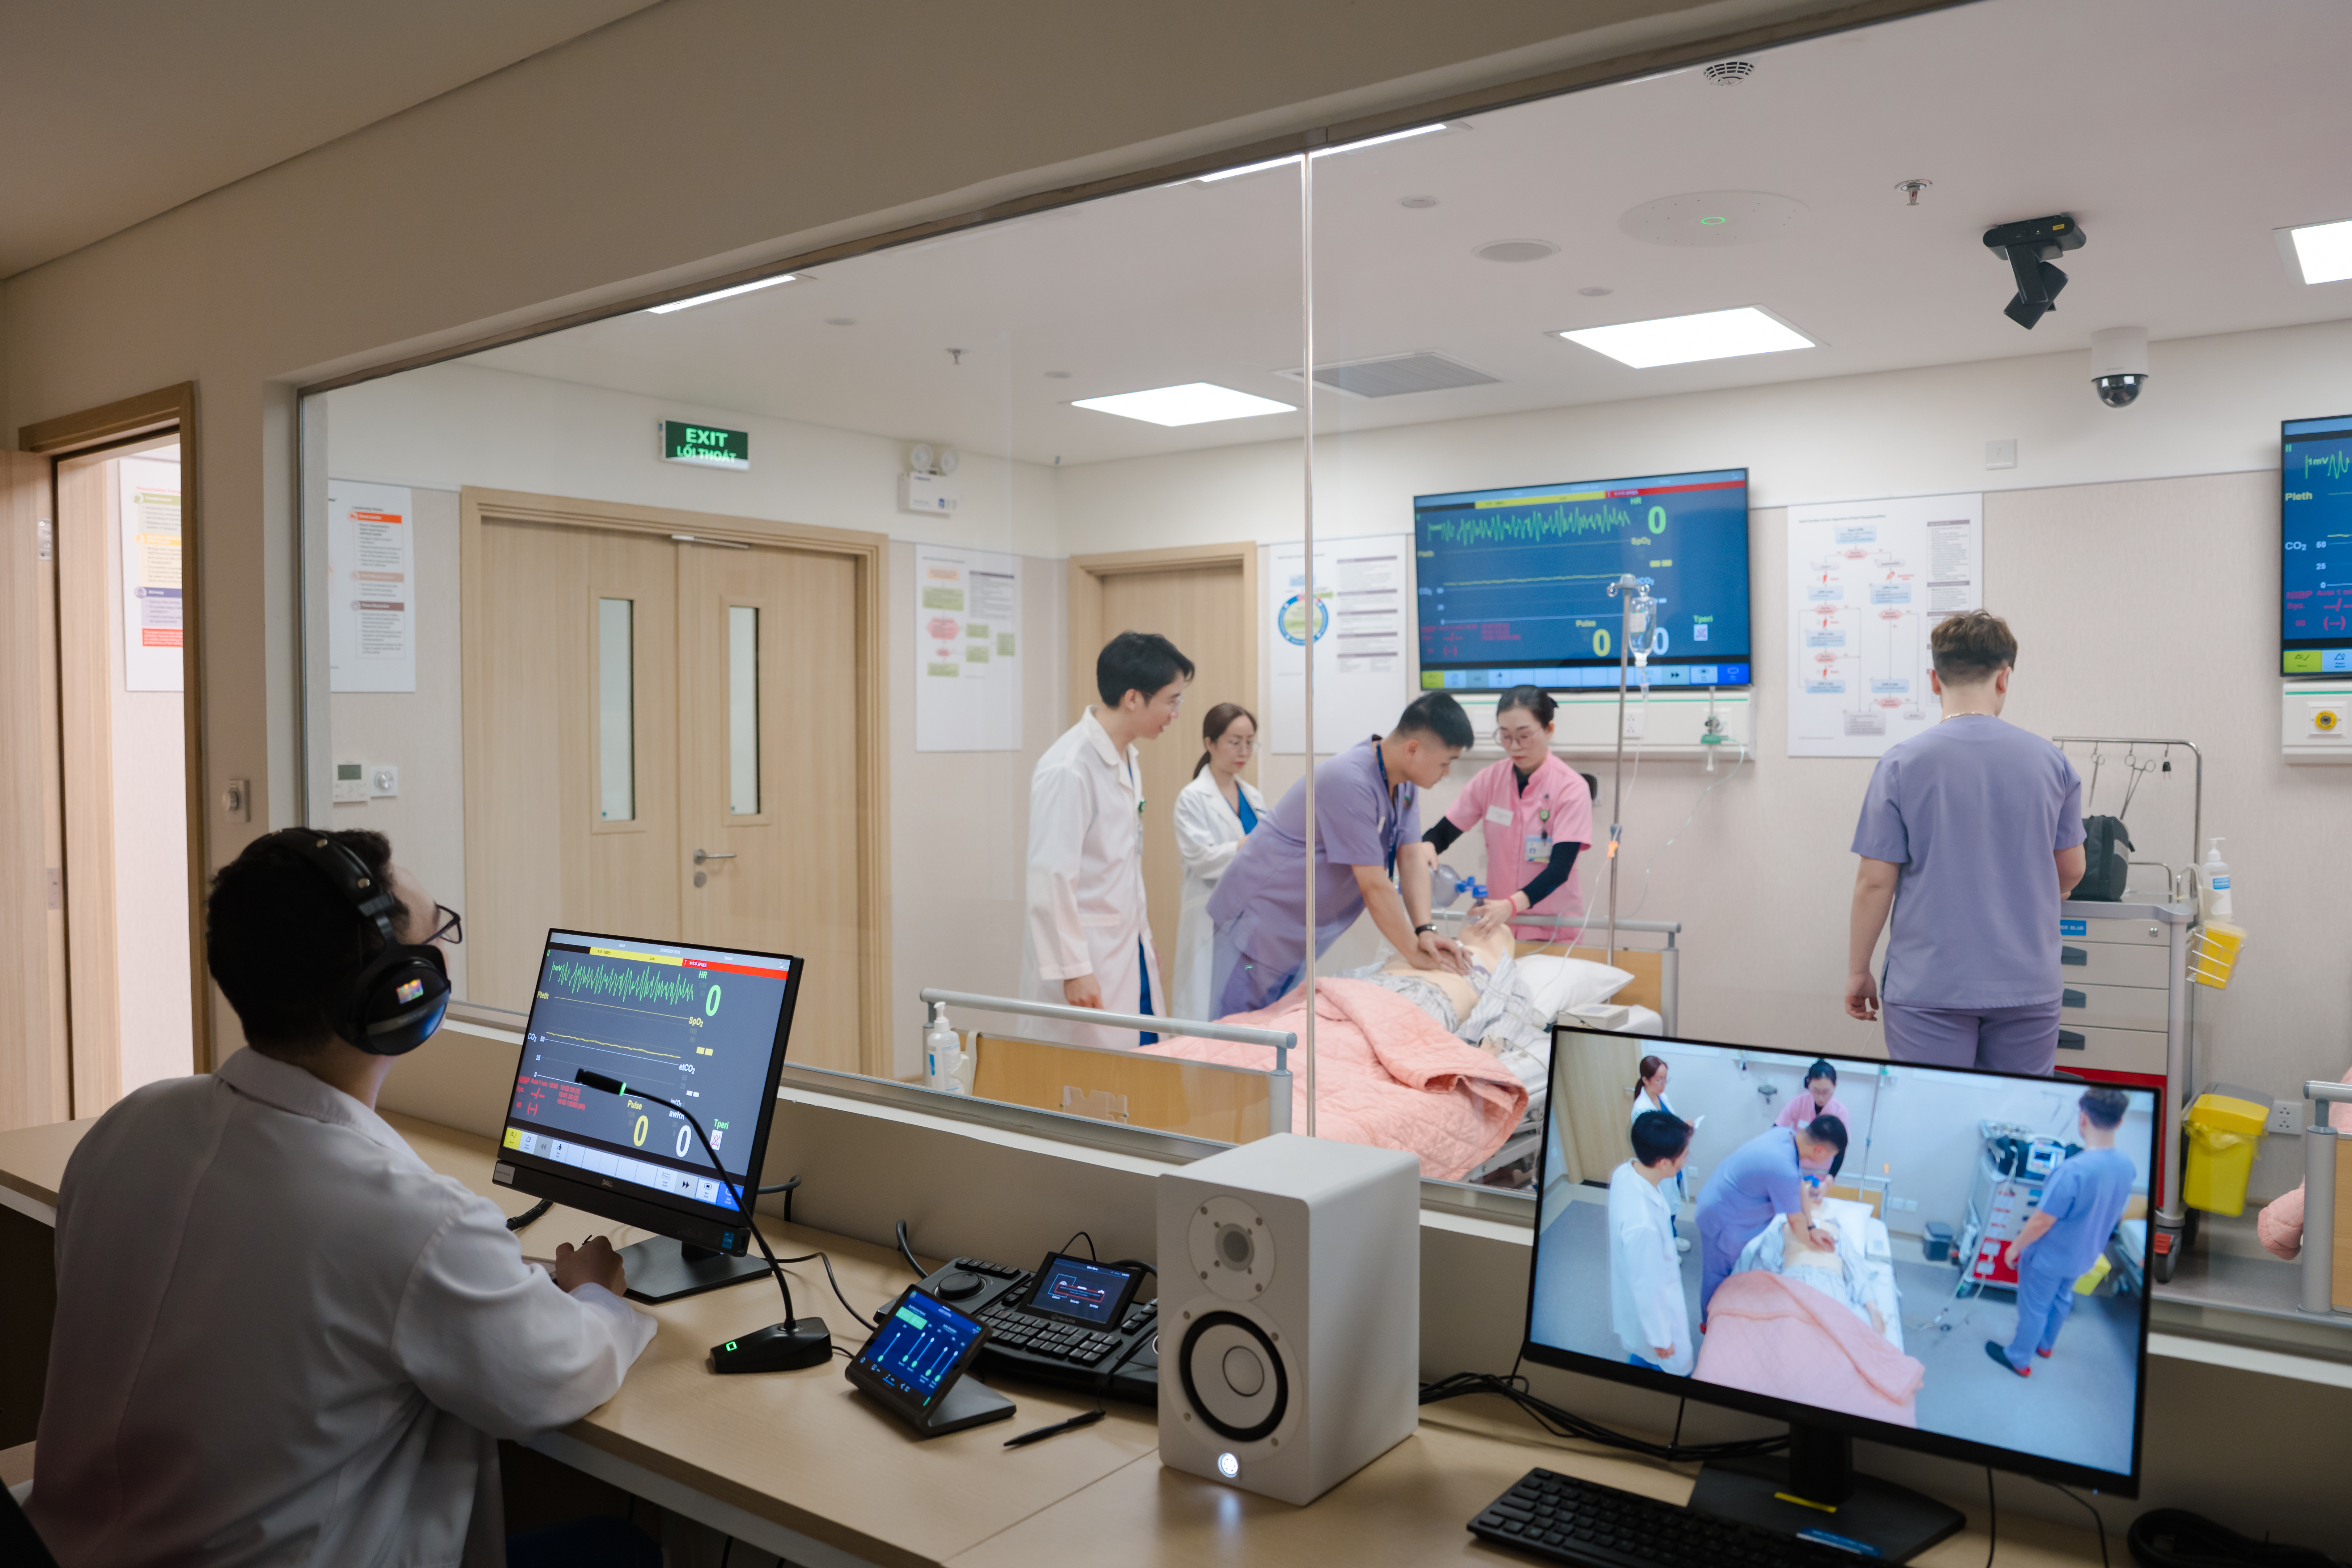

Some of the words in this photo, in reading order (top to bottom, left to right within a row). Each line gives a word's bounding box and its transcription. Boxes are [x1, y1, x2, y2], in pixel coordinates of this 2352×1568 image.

[685, 428, 728, 447] EXIT
[676, 443, 696, 458] LỐI
[697, 447, 736, 463] THOÁT
[2308, 456, 2329, 466] 1mV
[2285, 492, 2313, 501] Pleth
[1648, 505, 1667, 534] 0
[2285, 541, 2307, 551] CO2
[2286, 590, 2313, 600] NIBP
[1693, 615, 1713, 624] Tperi
[1593, 629, 1611, 657] 0
[1652, 626, 1669, 655] 0
[537, 991, 549, 999] Pleth
[706, 985, 721, 1016] 0
[689, 1016, 703, 1027] SpO2
[528, 1033, 537, 1042] CO2
[679, 1063, 696, 1074] etCO2
[627, 1100, 642, 1110] Pulse
[714, 1119, 729, 1129] Tperi
[633, 1115, 648, 1147] 0
[676, 1125, 692, 1157] 0
